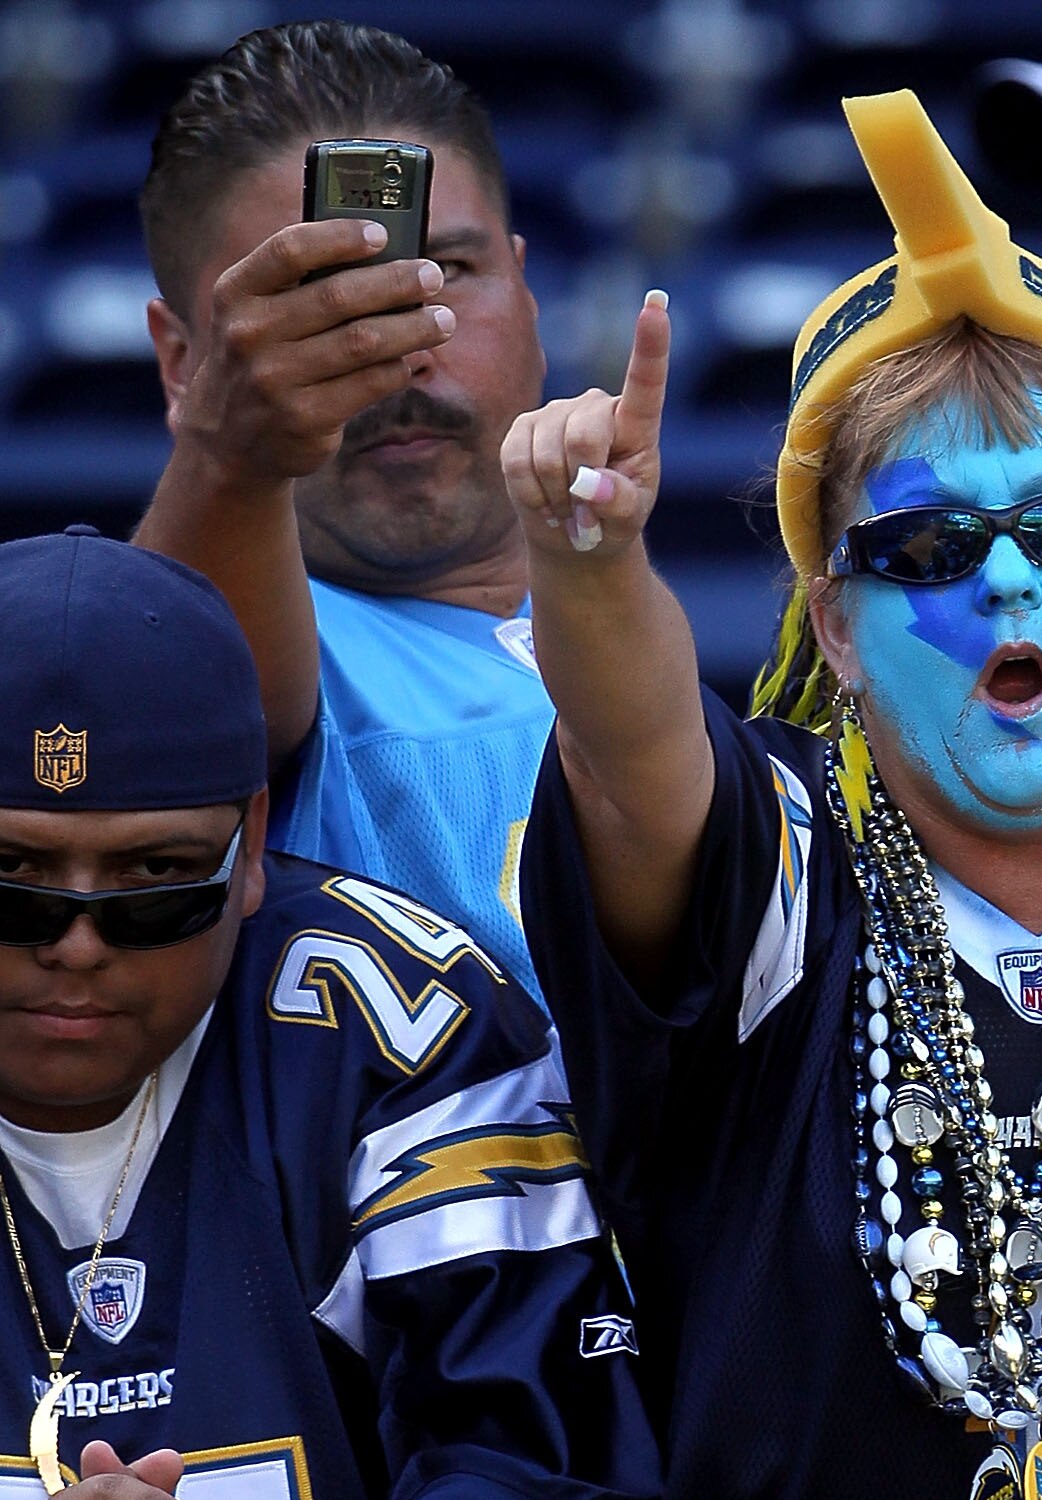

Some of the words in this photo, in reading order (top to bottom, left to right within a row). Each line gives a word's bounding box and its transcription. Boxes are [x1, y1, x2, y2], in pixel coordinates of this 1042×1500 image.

[39, 756, 82, 784] NFL
[265, 874, 508, 1077] 24
[95, 1302, 124, 1324] NFL
